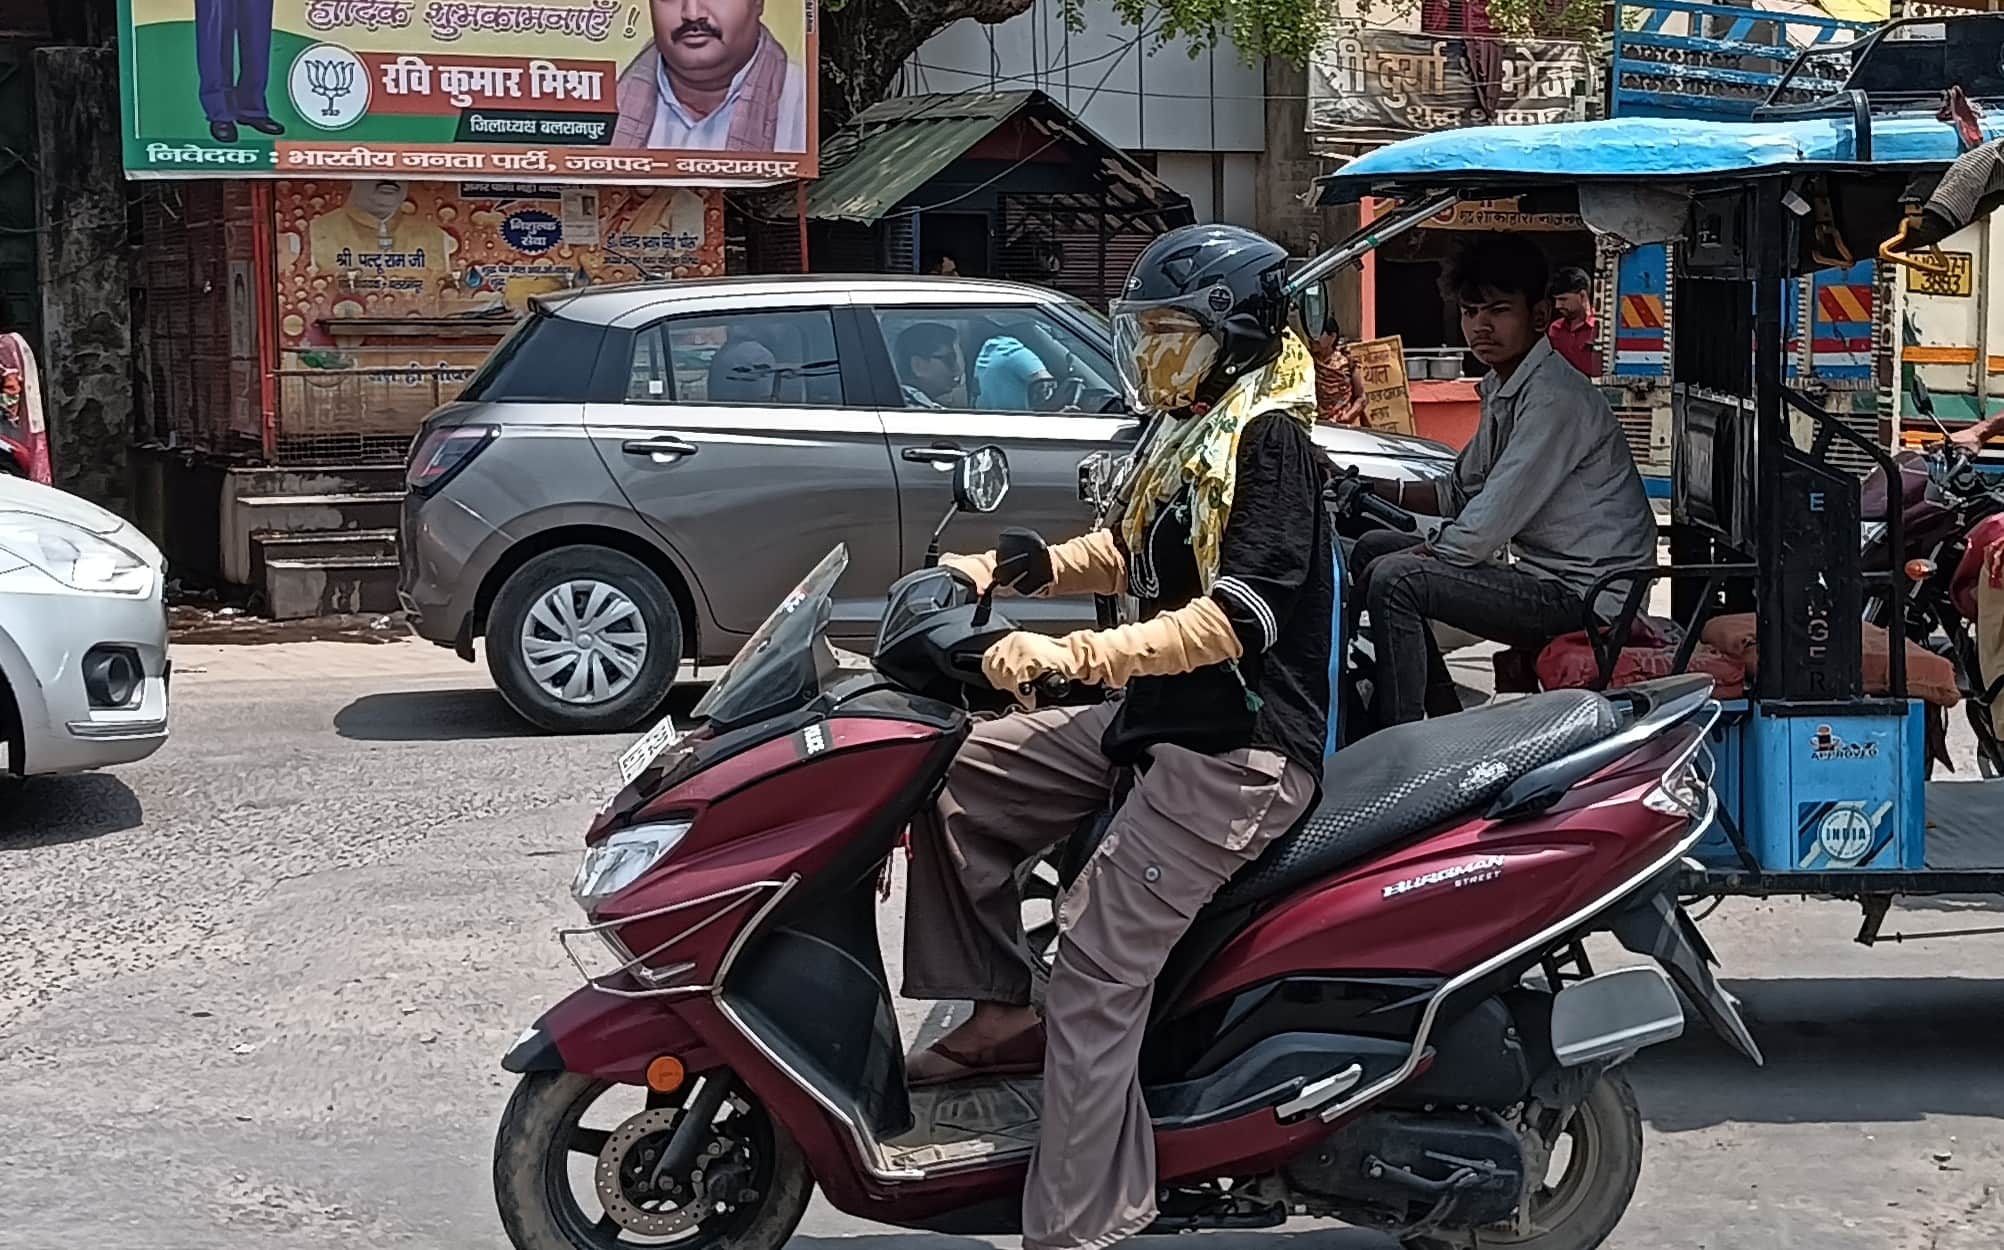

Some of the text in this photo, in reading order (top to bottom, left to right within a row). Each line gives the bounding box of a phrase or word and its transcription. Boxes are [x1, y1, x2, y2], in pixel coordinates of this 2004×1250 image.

[379, 56, 603, 107] रवि कुमार मिश्रा
[1312, 38, 1368, 93] श्री
[1376, 41, 1447, 107] दुर्गा
[470, 114, 606, 140] जिलाध्यक्ष बलरामपुर
[146, 143, 260, 163] निवेदक
[288, 147, 396, 167] भारतीय
[402, 151, 486, 169] जनता
[491, 150, 557, 171] पार्टी,
[675, 157, 799, 178] बलरामपुर
[521, 234, 547, 246] सेवा
[336, 248, 352, 267] श्री
[408, 248, 425, 268] जी
[1826, 827, 1866, 841] INDIA
[1382, 855, 1505, 897] BURGMAN
[1454, 870, 1501, 887] STREET
